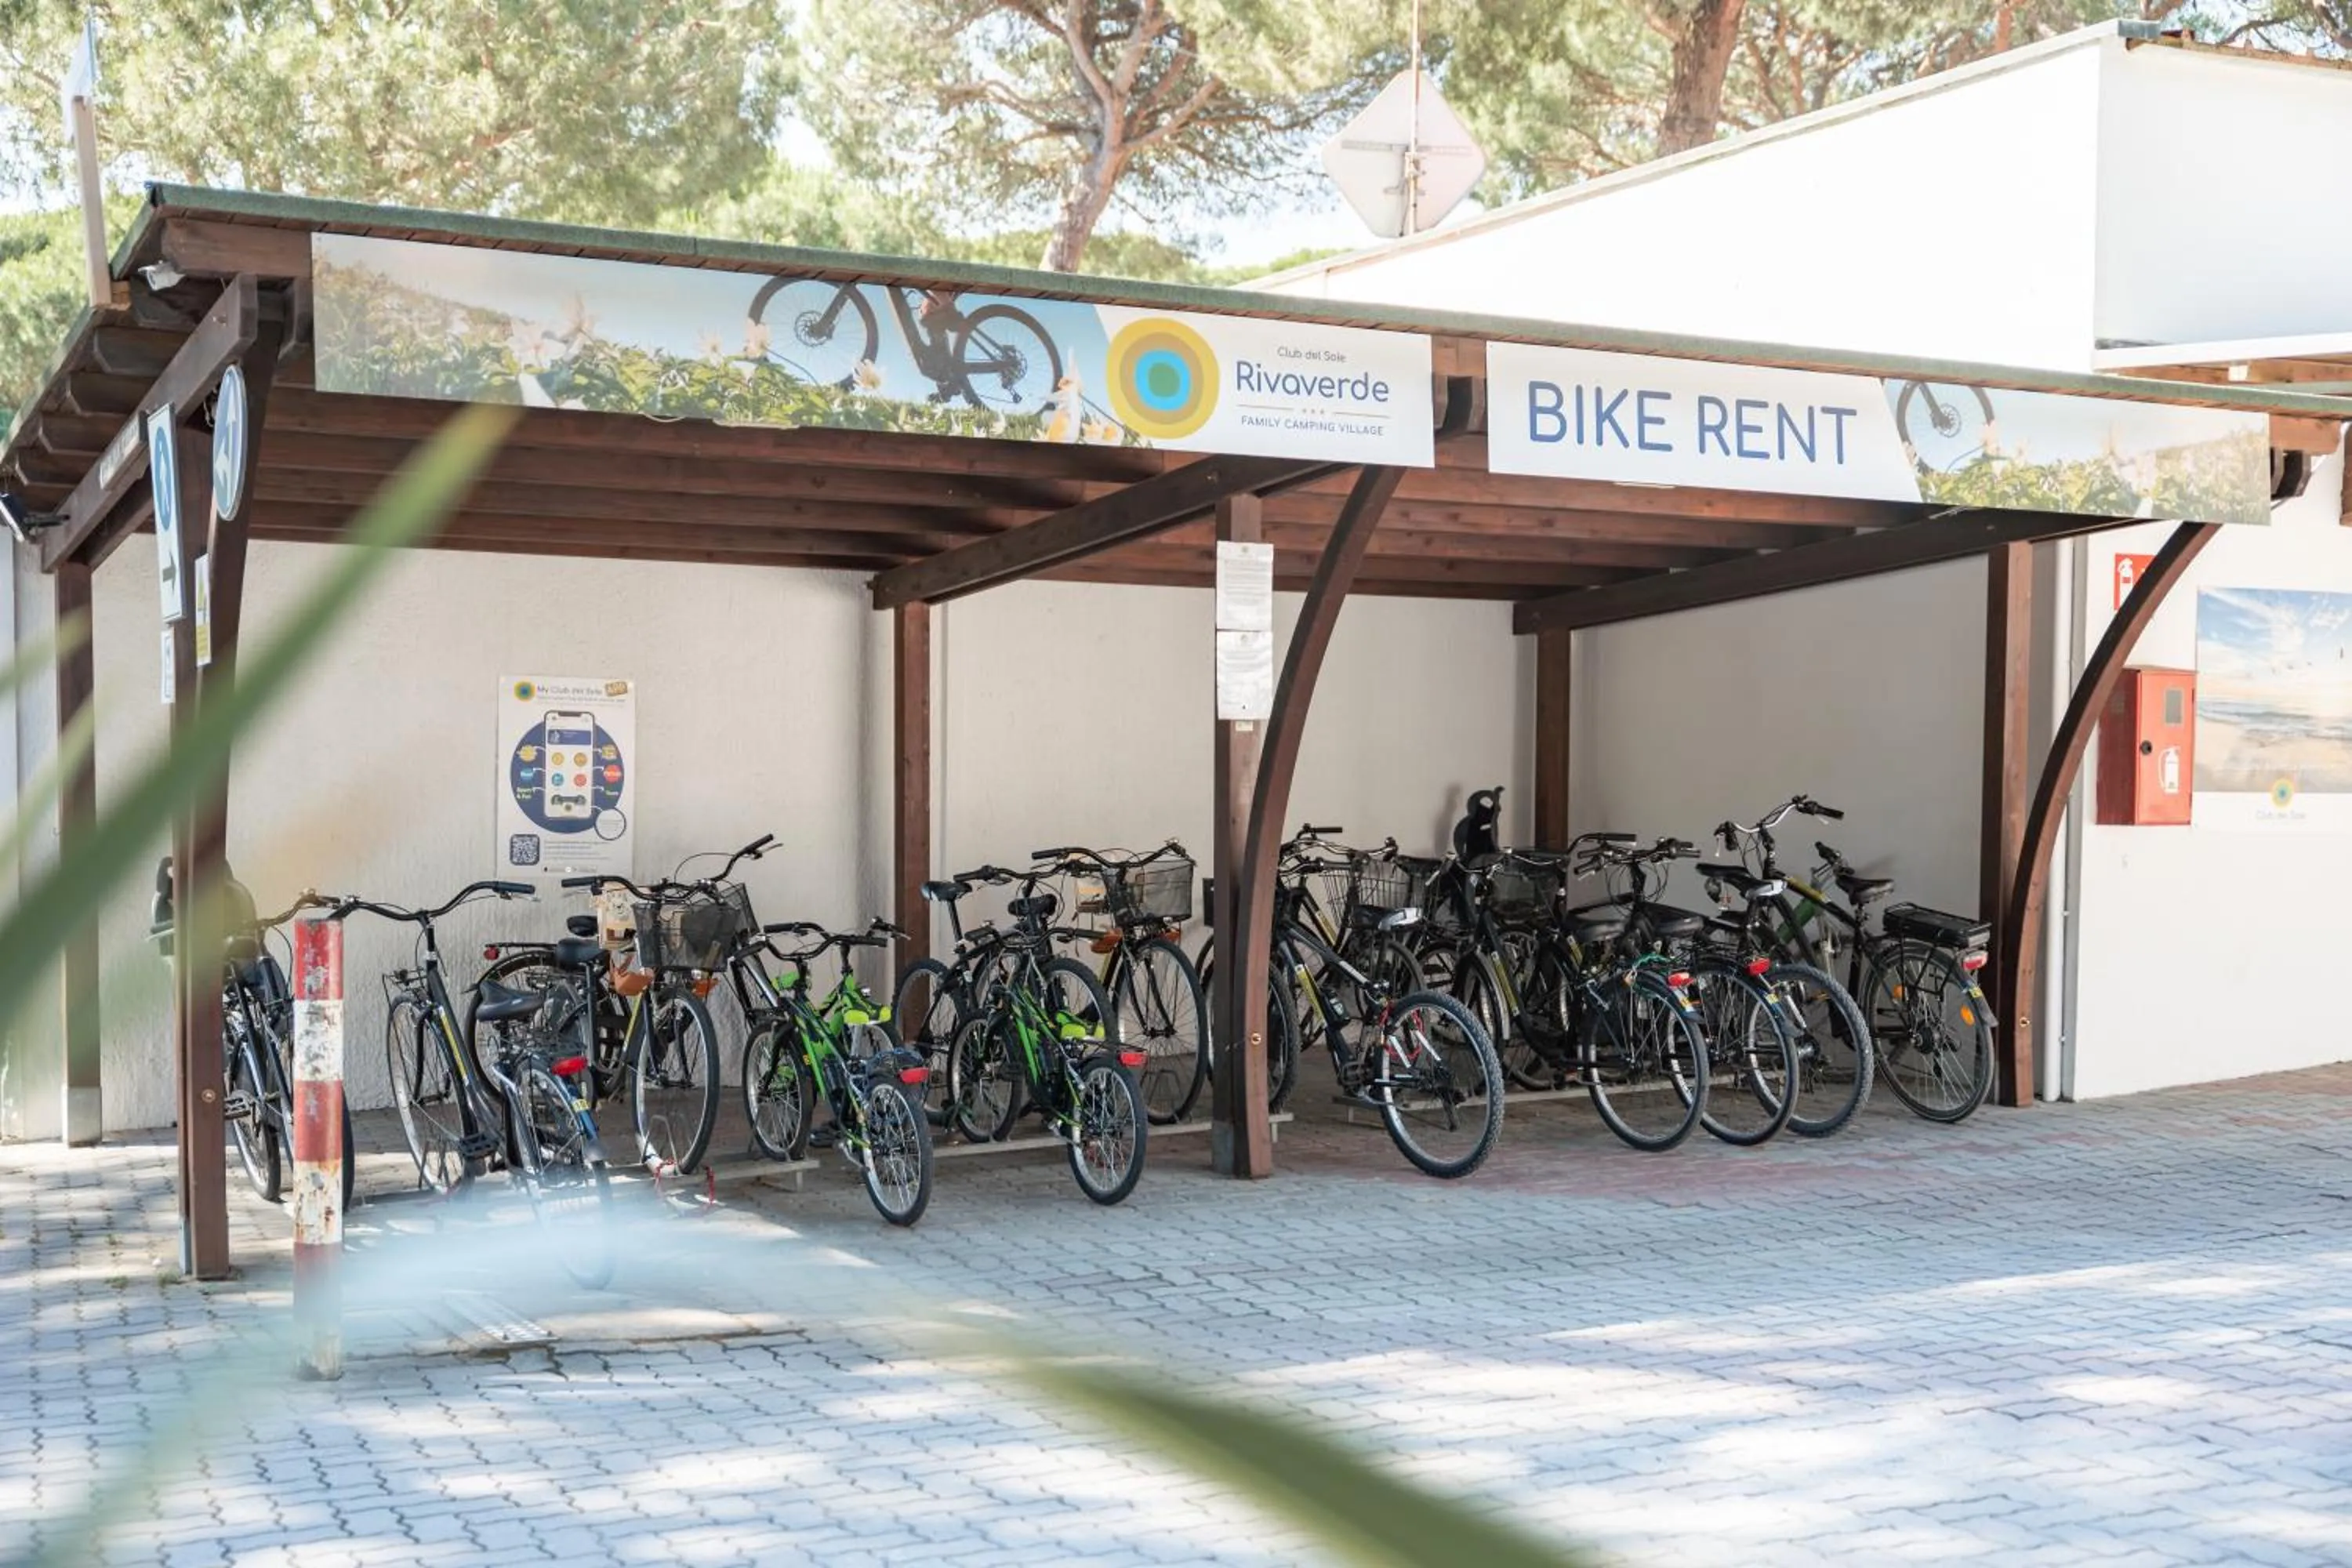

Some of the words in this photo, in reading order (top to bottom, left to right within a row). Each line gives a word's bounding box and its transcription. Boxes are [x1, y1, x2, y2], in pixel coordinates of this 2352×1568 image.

[1277, 347, 1302, 361] Club
[1306, 349, 1322, 361] del
[1323, 350, 1347, 363] Sole
[1236, 361, 1389, 403] Rivaverde
[1240, 415, 1281, 429] FAMILY
[1284, 418, 1335, 433] CAMPING
[1338, 422, 1385, 436] VILLAGE
[1528, 380, 1673, 452] BIKE
[1697, 396, 1857, 465] RENT
